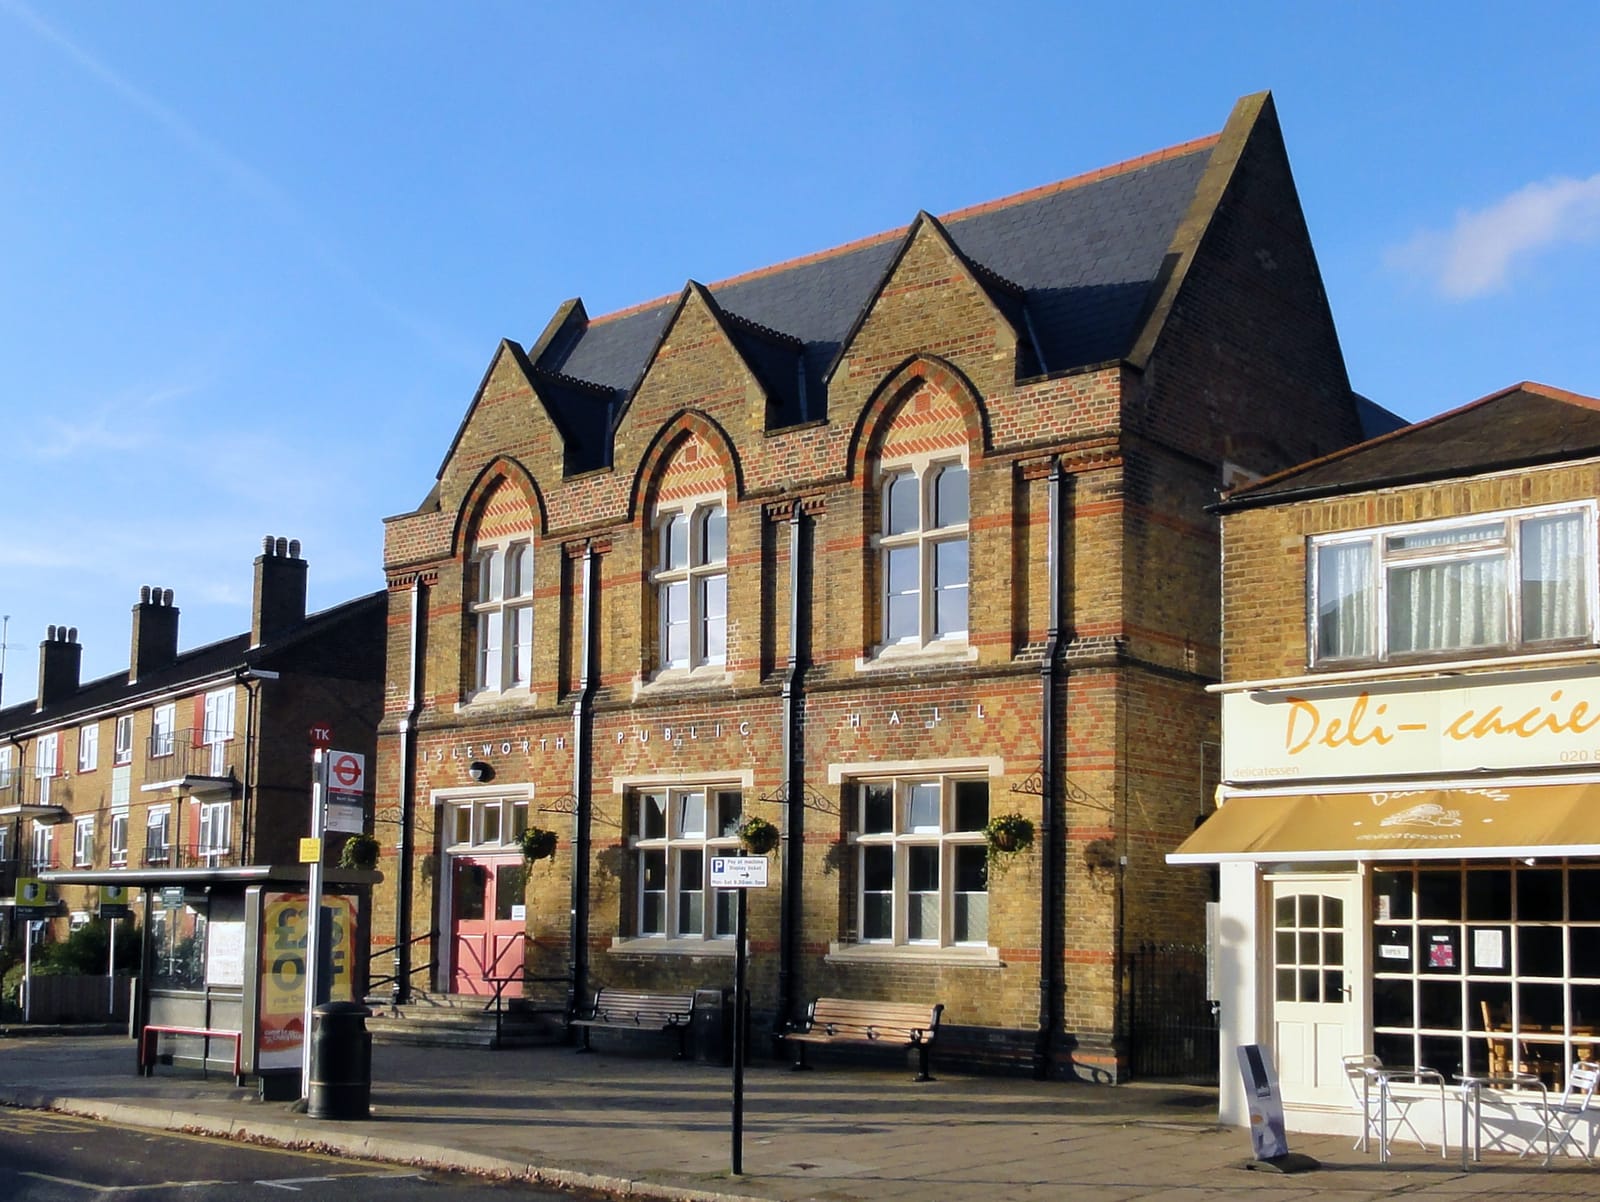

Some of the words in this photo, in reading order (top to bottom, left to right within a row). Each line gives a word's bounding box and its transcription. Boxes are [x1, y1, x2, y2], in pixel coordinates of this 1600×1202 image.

[1442, 689, 1600, 741] cacie
[314, 728, 330, 741] TK
[423, 737, 564, 762] ISLEWORTH
[617, 721, 749, 744] PUBLIC
[850, 703, 985, 728] HALL
[1559, 750, 1589, 762] 020
[1232, 765, 1300, 778] delicatessen
